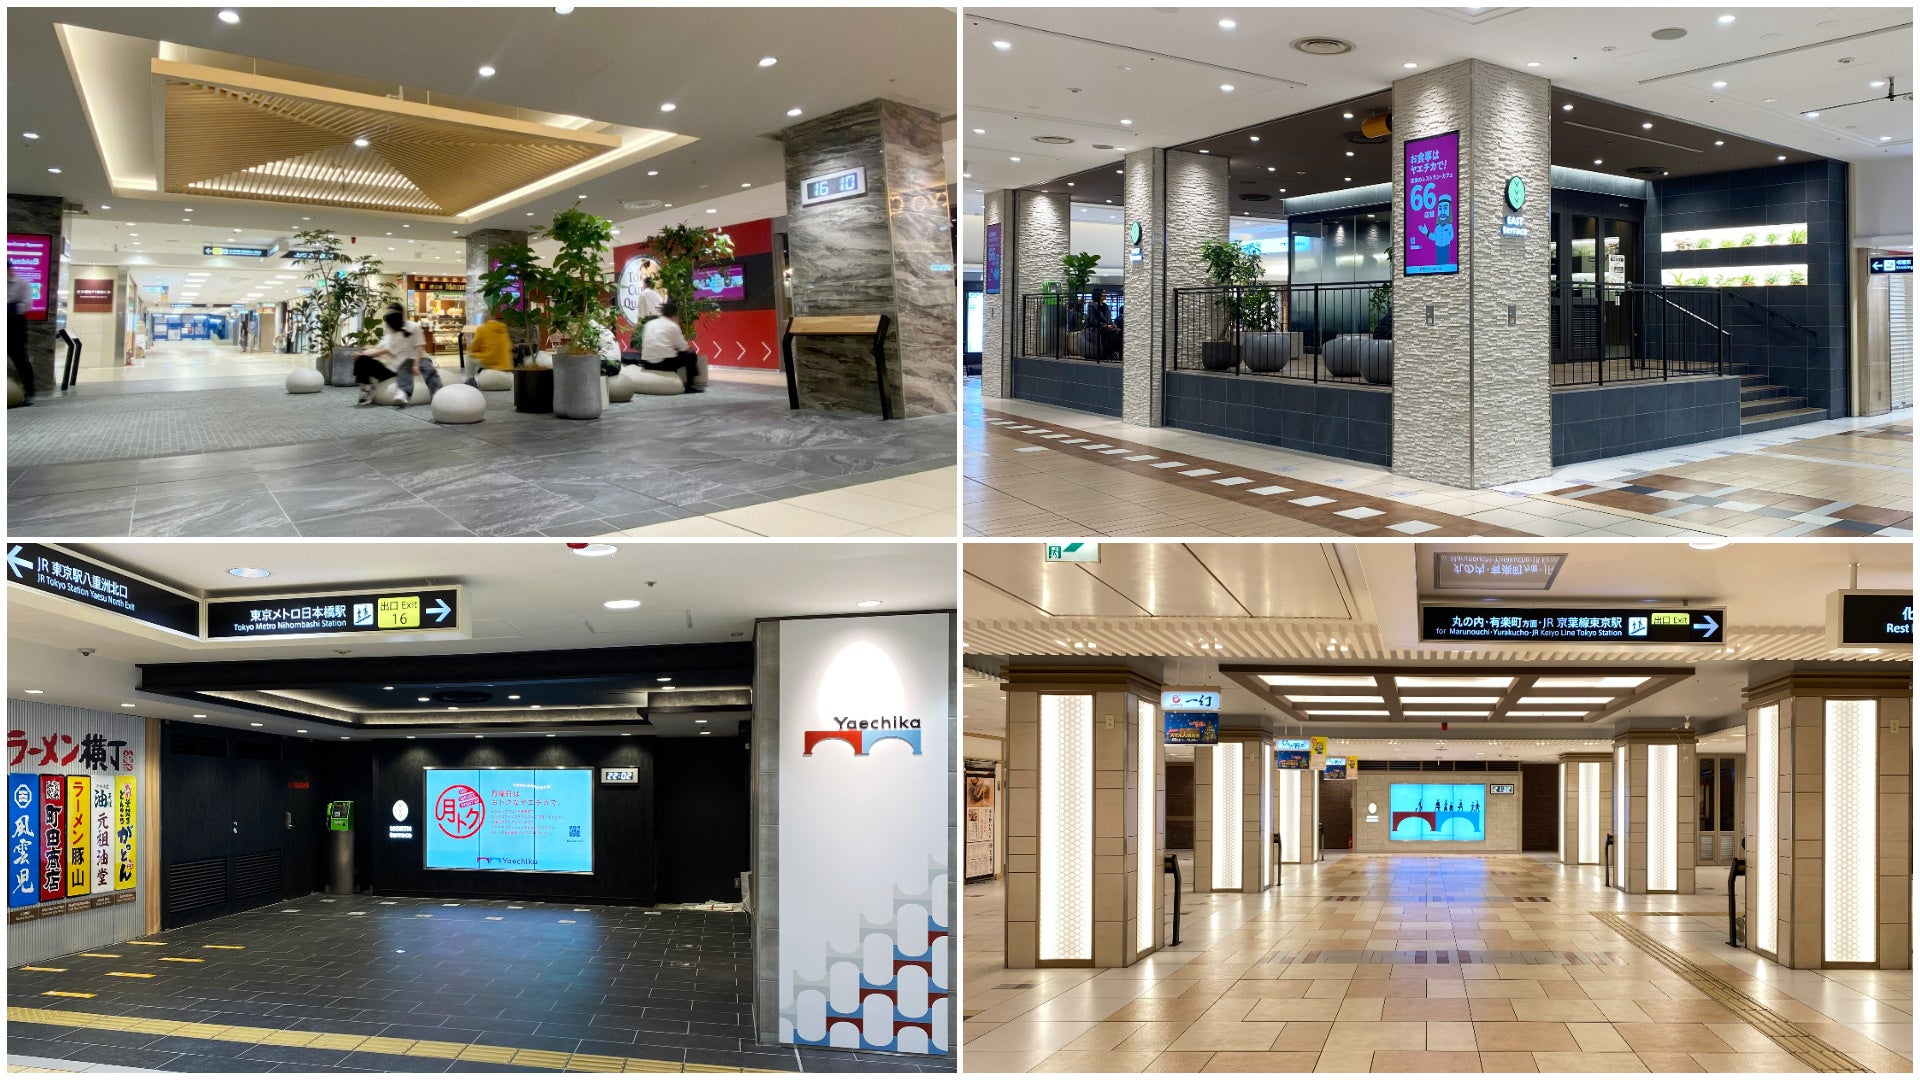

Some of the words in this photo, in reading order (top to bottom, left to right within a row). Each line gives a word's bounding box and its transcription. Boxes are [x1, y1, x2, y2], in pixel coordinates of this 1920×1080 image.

[813, 181, 829, 197] 16
[839, 174, 856, 191] 10
[1410, 182, 1437, 211] 66
[1506, 216, 1524, 226] EAST
[37, 556, 49, 573] JR
[51, 561, 128, 599] 東京駅八重洲北口
[37, 573, 46, 583] JR
[46, 575, 66, 590] Tokyo
[67, 582, 89, 597] Station
[90, 589, 108, 603] Yaesu
[108, 595, 125, 608] North
[124, 601, 135, 612] Exit
[380, 601, 398, 611] 出口
[401, 601, 418, 610] Exit
[250, 605, 347, 622] 東京メトロ日本橋駅
[392, 613, 408, 625] 16
[1654, 616, 1671, 624] 出口
[1673, 616, 1688, 624] Exit
[234, 623, 254, 632] Tokyo
[255, 621, 277, 631] Metro
[277, 620, 320, 629] Nihombashi
[321, 618, 347, 628] Station
[1557, 616, 1623, 629] 京葉線東京駅
[1886, 622, 1910, 634] Rest
[1540, 628, 1559, 638] Keiyo
[1577, 629, 1596, 637] Tokyo
[833, 716, 921, 730] Yaechika
[7, 729, 127, 771] ラーメン横丁
[606, 772, 633, 780] 22:02
[71, 781, 85, 888] ラーメン豚山
[43, 804, 63, 892] 町田商店
[96, 812, 109, 886] 元祖油堂
[117, 825, 134, 882] がっとん
[502, 857, 538, 865] Yaechika
